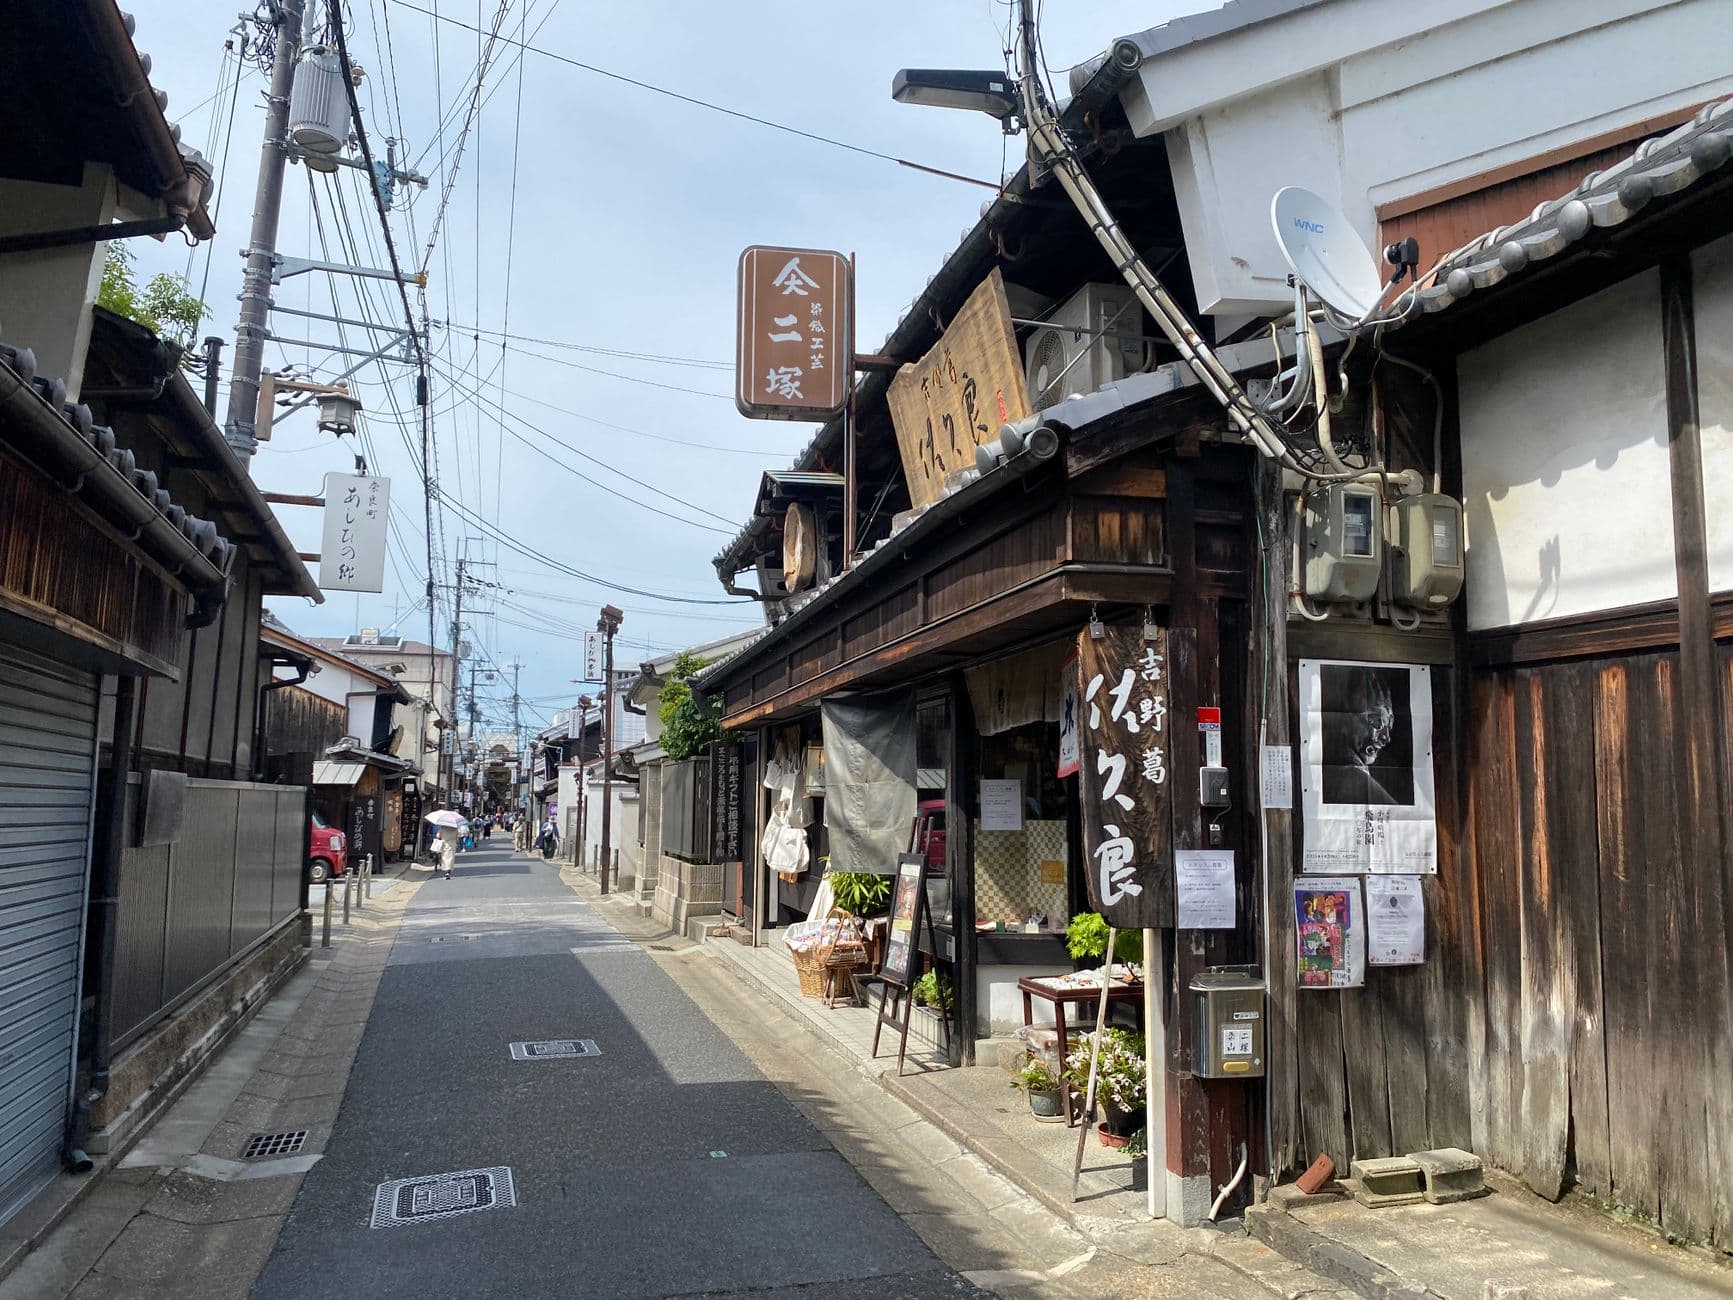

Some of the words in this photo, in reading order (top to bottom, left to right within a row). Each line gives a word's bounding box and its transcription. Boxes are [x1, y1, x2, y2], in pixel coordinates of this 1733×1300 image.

[1294, 217, 1324, 234] WNC
[366, 480, 380, 520] 奈良町
[1139, 648, 1167, 784] 吉野葛
[1086, 668, 1143, 906] 佐久良
